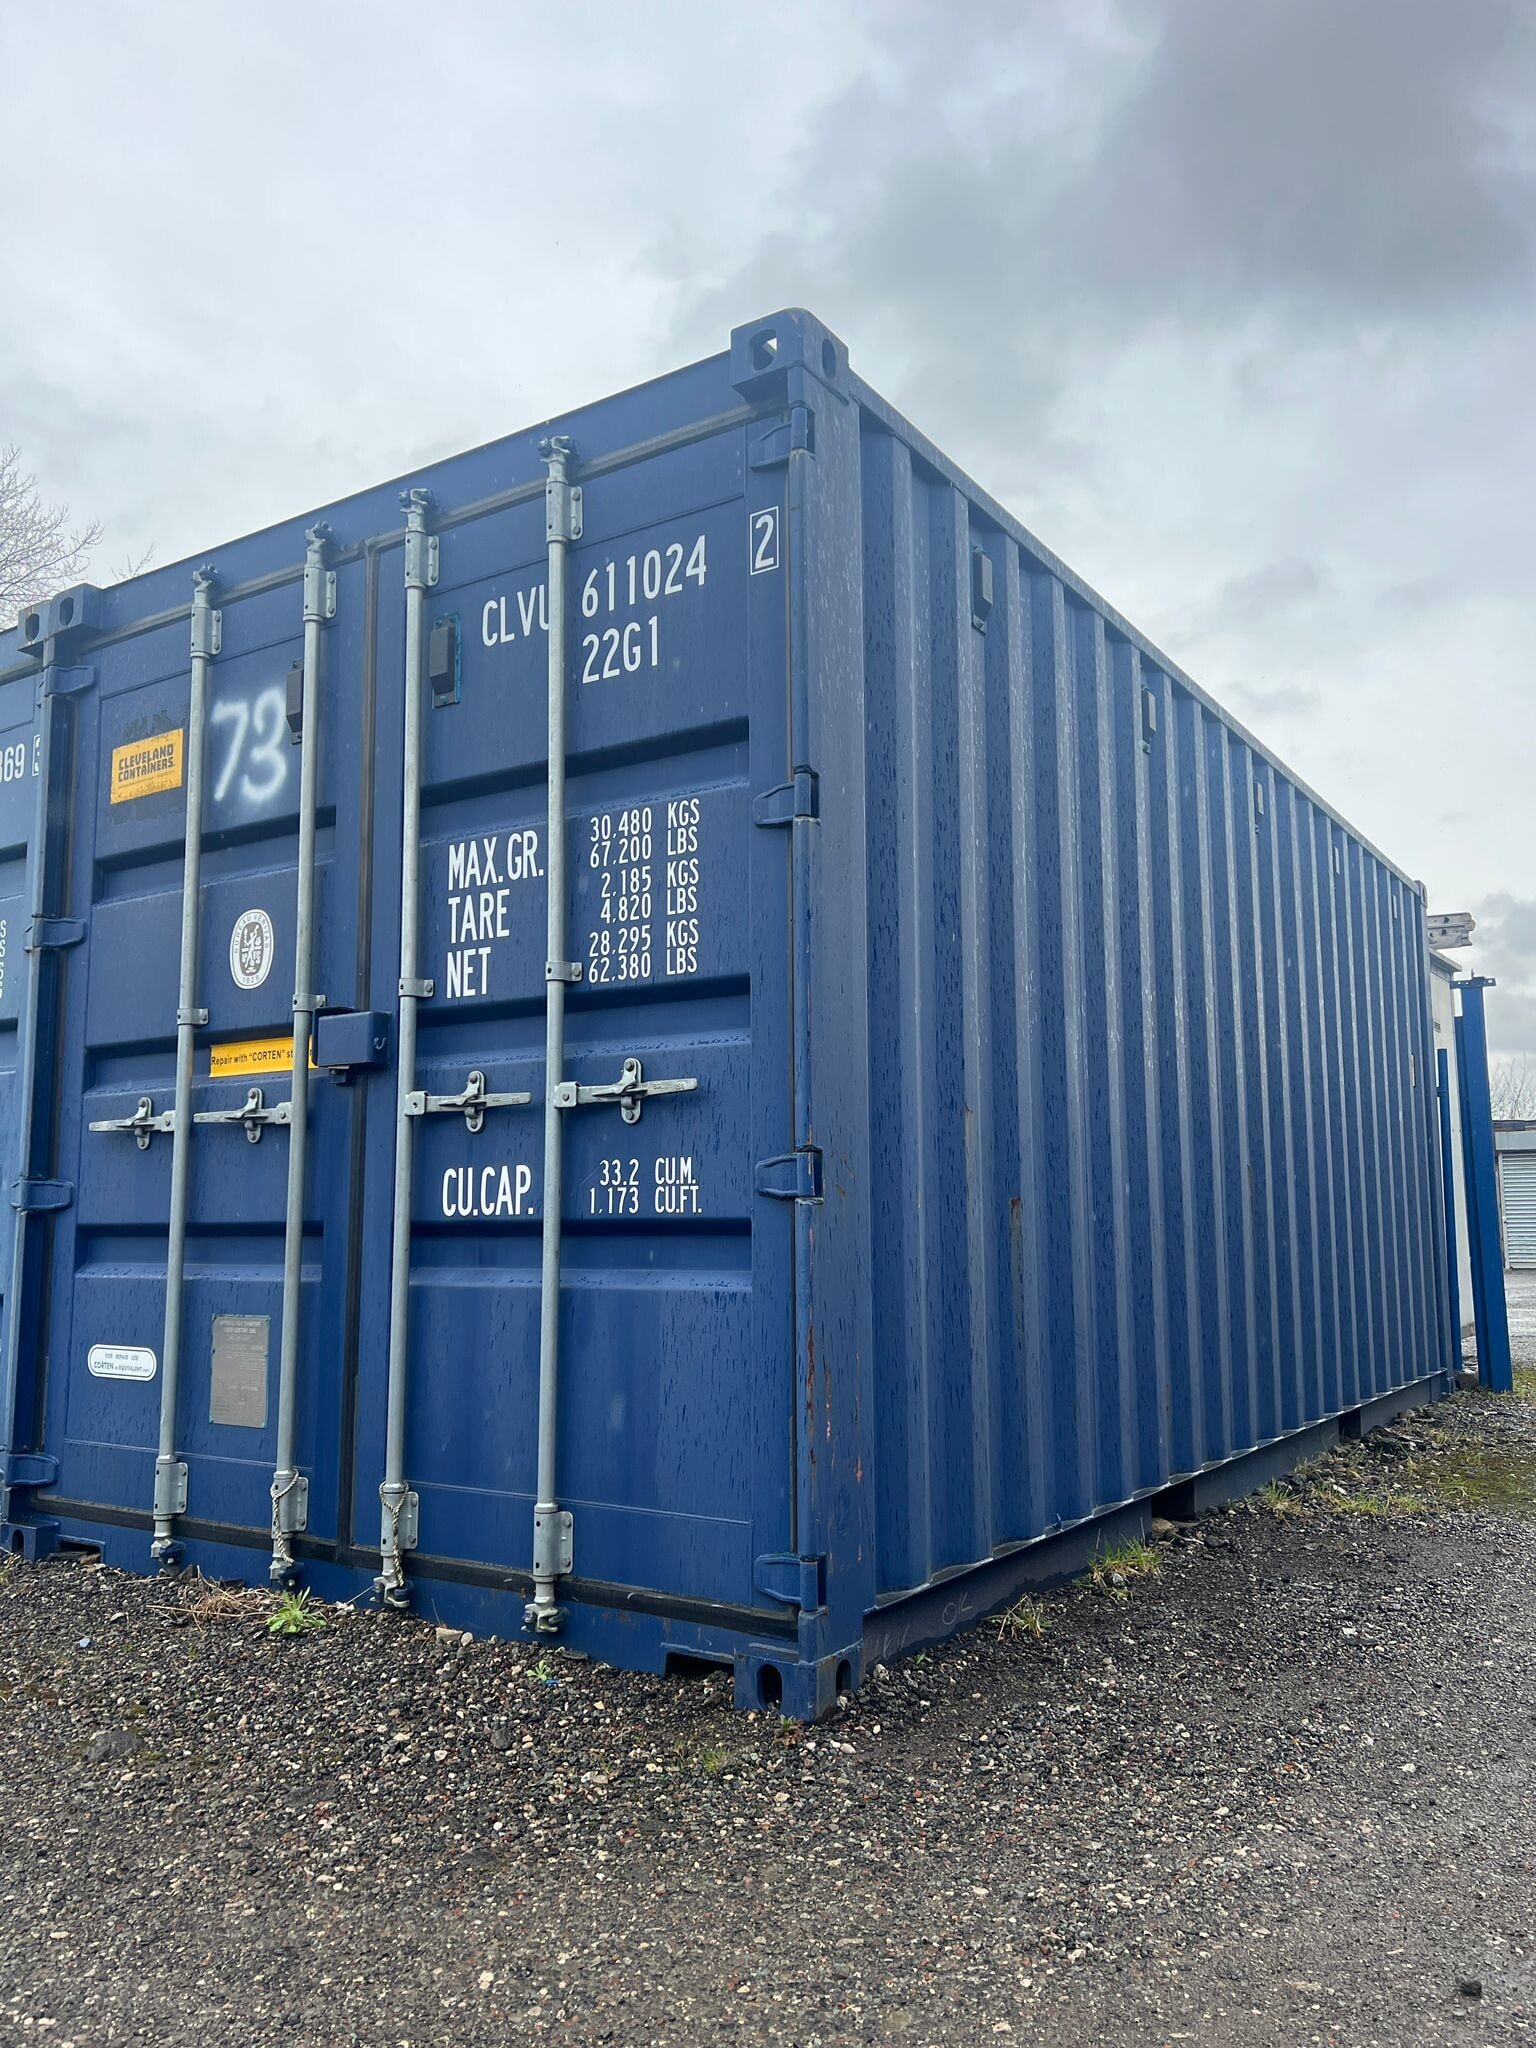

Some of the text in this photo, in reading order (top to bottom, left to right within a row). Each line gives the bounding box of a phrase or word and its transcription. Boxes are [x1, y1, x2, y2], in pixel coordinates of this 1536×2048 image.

[483, 514, 775, 646] CLVU 611024 2
[582, 616, 658, 684] 22G1
[0, 743, 25, 783] 69
[118, 743, 174, 771] CLEVELAND
[211, 686, 287, 803] 73
[590, 798, 700, 842] 30,480 KGS
[590, 825, 698, 868] 67,200 LBS
[667, 857, 699, 888] KGS
[447, 888, 510, 944] TARE
[667, 885, 698, 916] LBS
[589, 918, 699, 958] 28,295 KGS
[446, 946, 492, 999] NET
[588, 946, 698, 984] 62,380 LBS
[211, 1056, 233, 1067] Repair
[234, 1053, 248, 1063] with
[442, 1164, 534, 1217] CU.CAP.
[599, 1158, 639, 1186] 33.2
[93, 1360, 114, 1370] CORTEN
